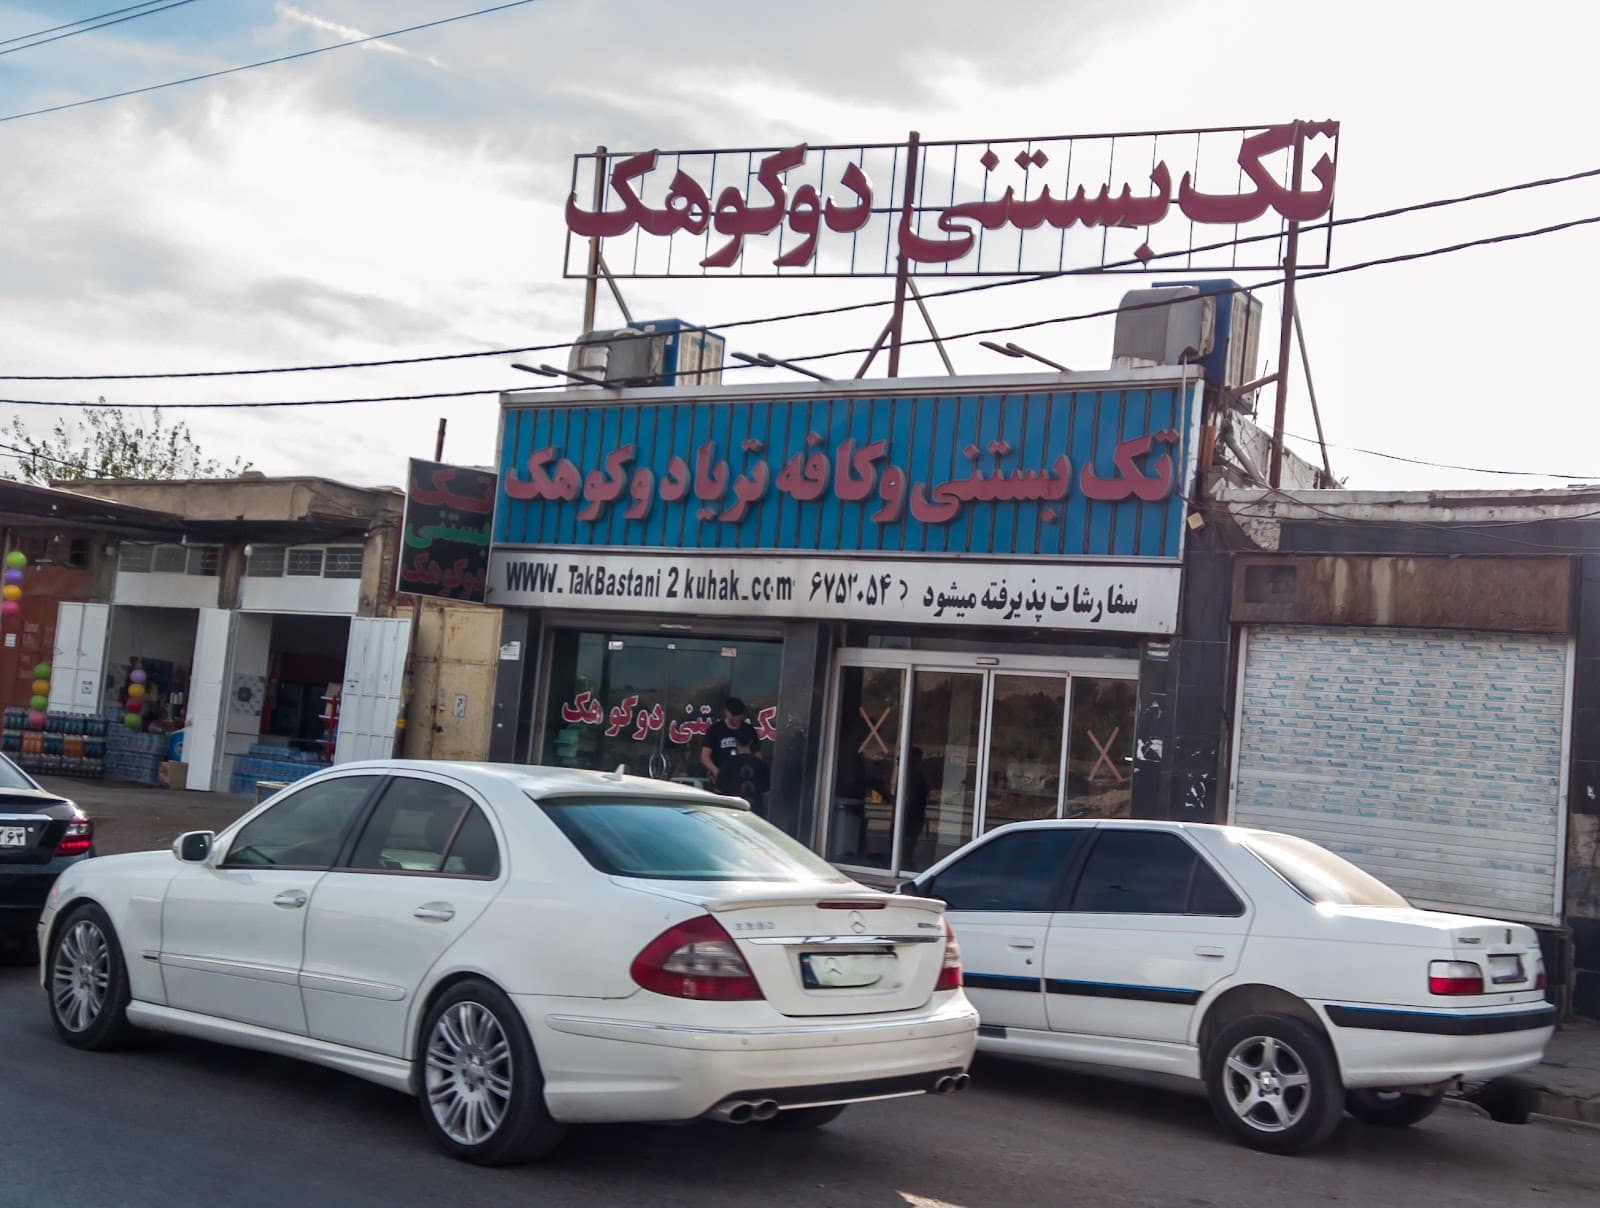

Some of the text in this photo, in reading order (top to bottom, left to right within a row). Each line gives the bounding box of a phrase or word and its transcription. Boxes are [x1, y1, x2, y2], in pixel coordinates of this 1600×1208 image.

[1178, 119, 1340, 223] تک
[898, 148, 1172, 265] بستنی
[911, 440, 1073, 524] بستنی
[1080, 428, 1180, 501] تک
[412, 467, 495, 514] تک
[405, 510, 491, 558] بستنی
[923, 581, 977, 617] میشود
[981, 578, 1046, 622] پذیرفته
[1050, 583, 1138, 623] سفارشات
[669, 703, 713, 743] تنی
